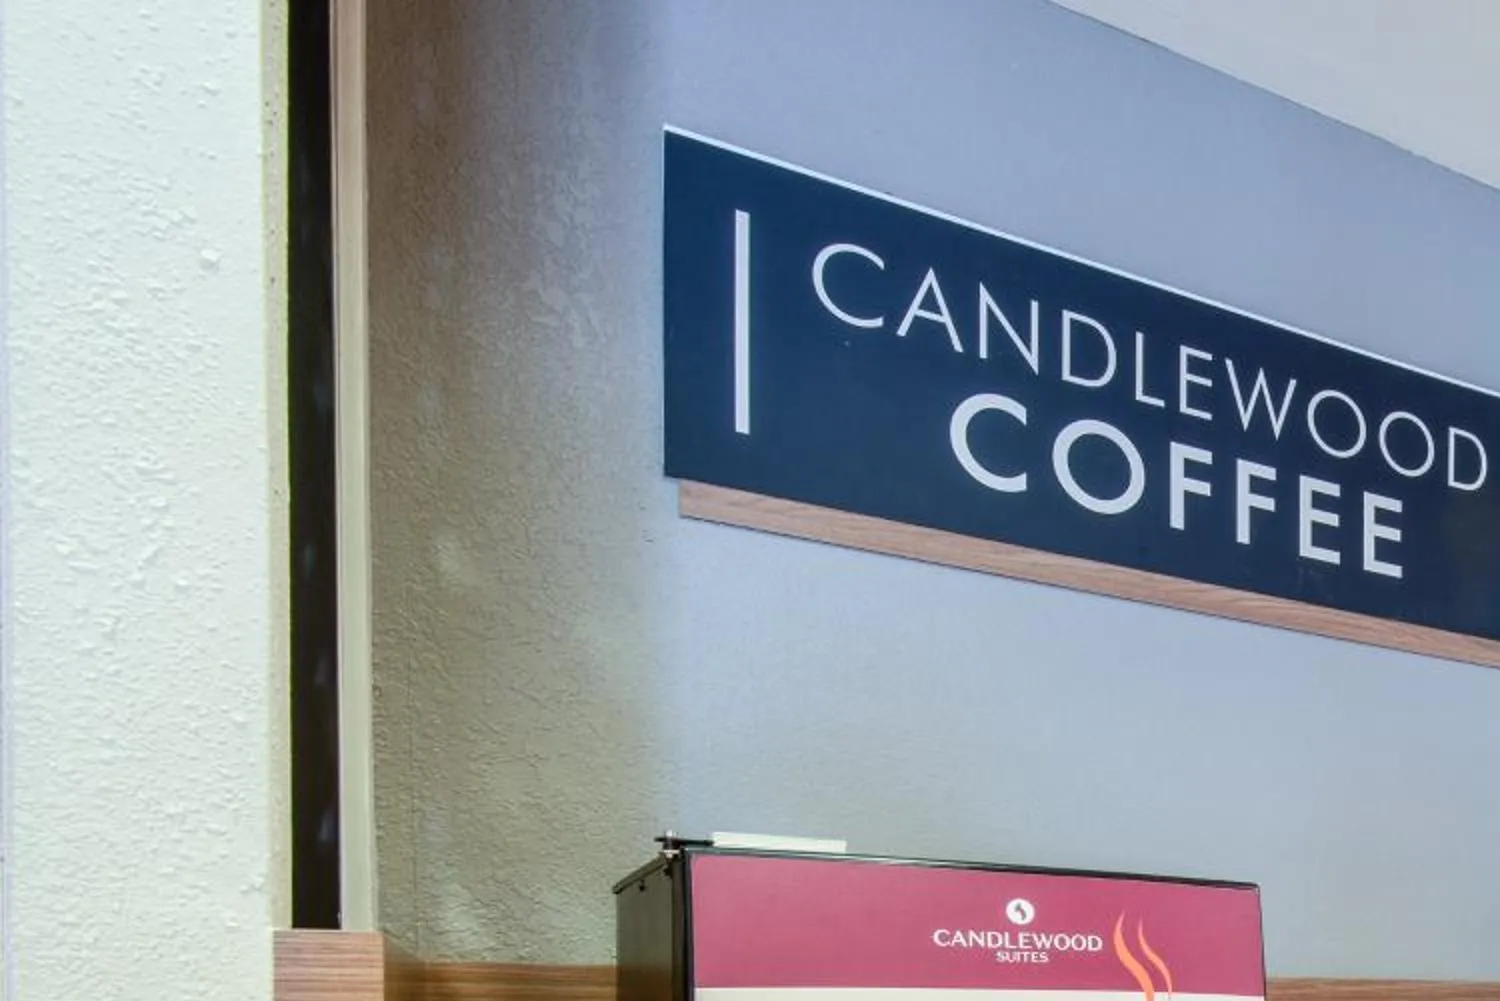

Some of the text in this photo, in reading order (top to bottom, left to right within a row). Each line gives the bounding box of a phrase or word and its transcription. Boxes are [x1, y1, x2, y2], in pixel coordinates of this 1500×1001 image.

[811, 242, 1488, 492] CANDLEWOOD
[949, 393, 1404, 579] COFFEE
[933, 929, 1103, 952] CANDLEWOOD
[996, 951, 1049, 963] SUITES
